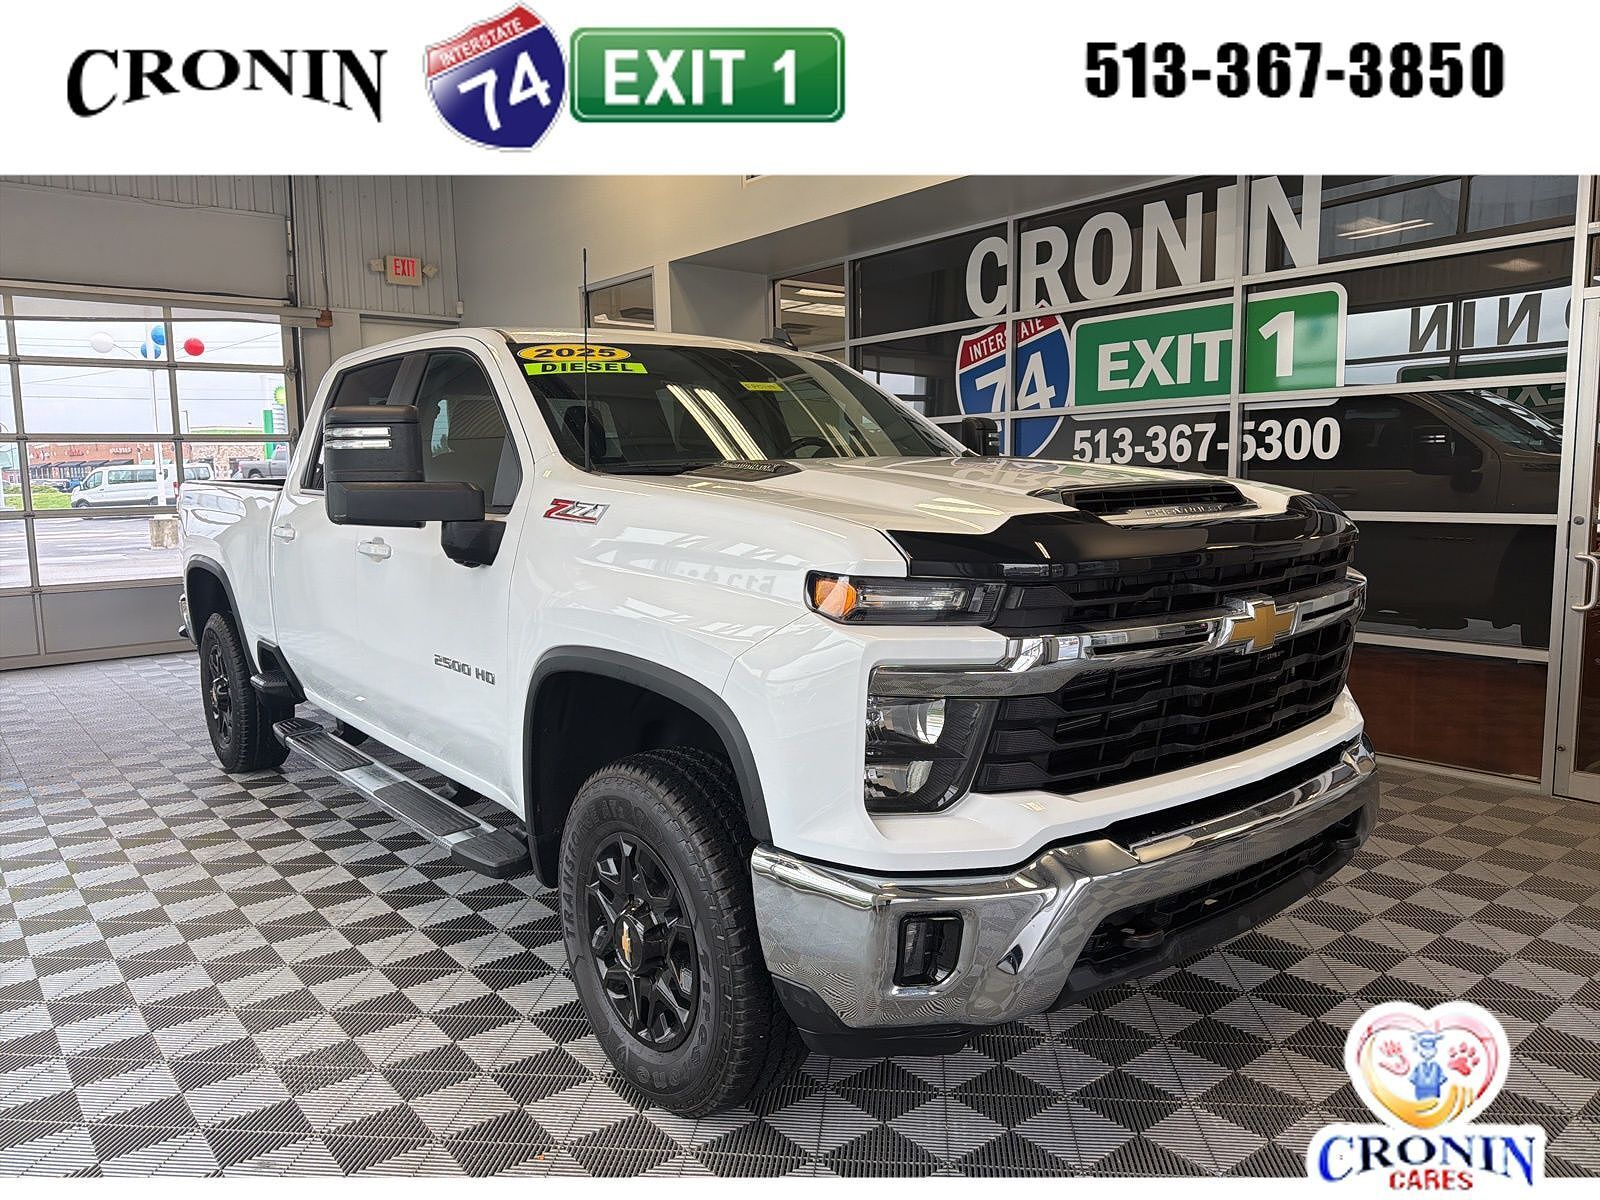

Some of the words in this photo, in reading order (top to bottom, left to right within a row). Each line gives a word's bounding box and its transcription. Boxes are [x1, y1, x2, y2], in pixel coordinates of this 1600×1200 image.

[965, 174, 1322, 319] CRONIN
[393, 256, 416, 278] EXIT
[533, 347, 617, 358] 2025
[968, 318, 1045, 362] INTERATE
[1098, 329, 1234, 391] EXIT
[1258, 310, 1296, 378] 1
[541, 362, 634, 373] DIESEL
[975, 351, 1056, 412] 74
[543, 498, 610, 525] Z71
[433, 653, 472, 677] 2500
[474, 667, 496, 686] HD
